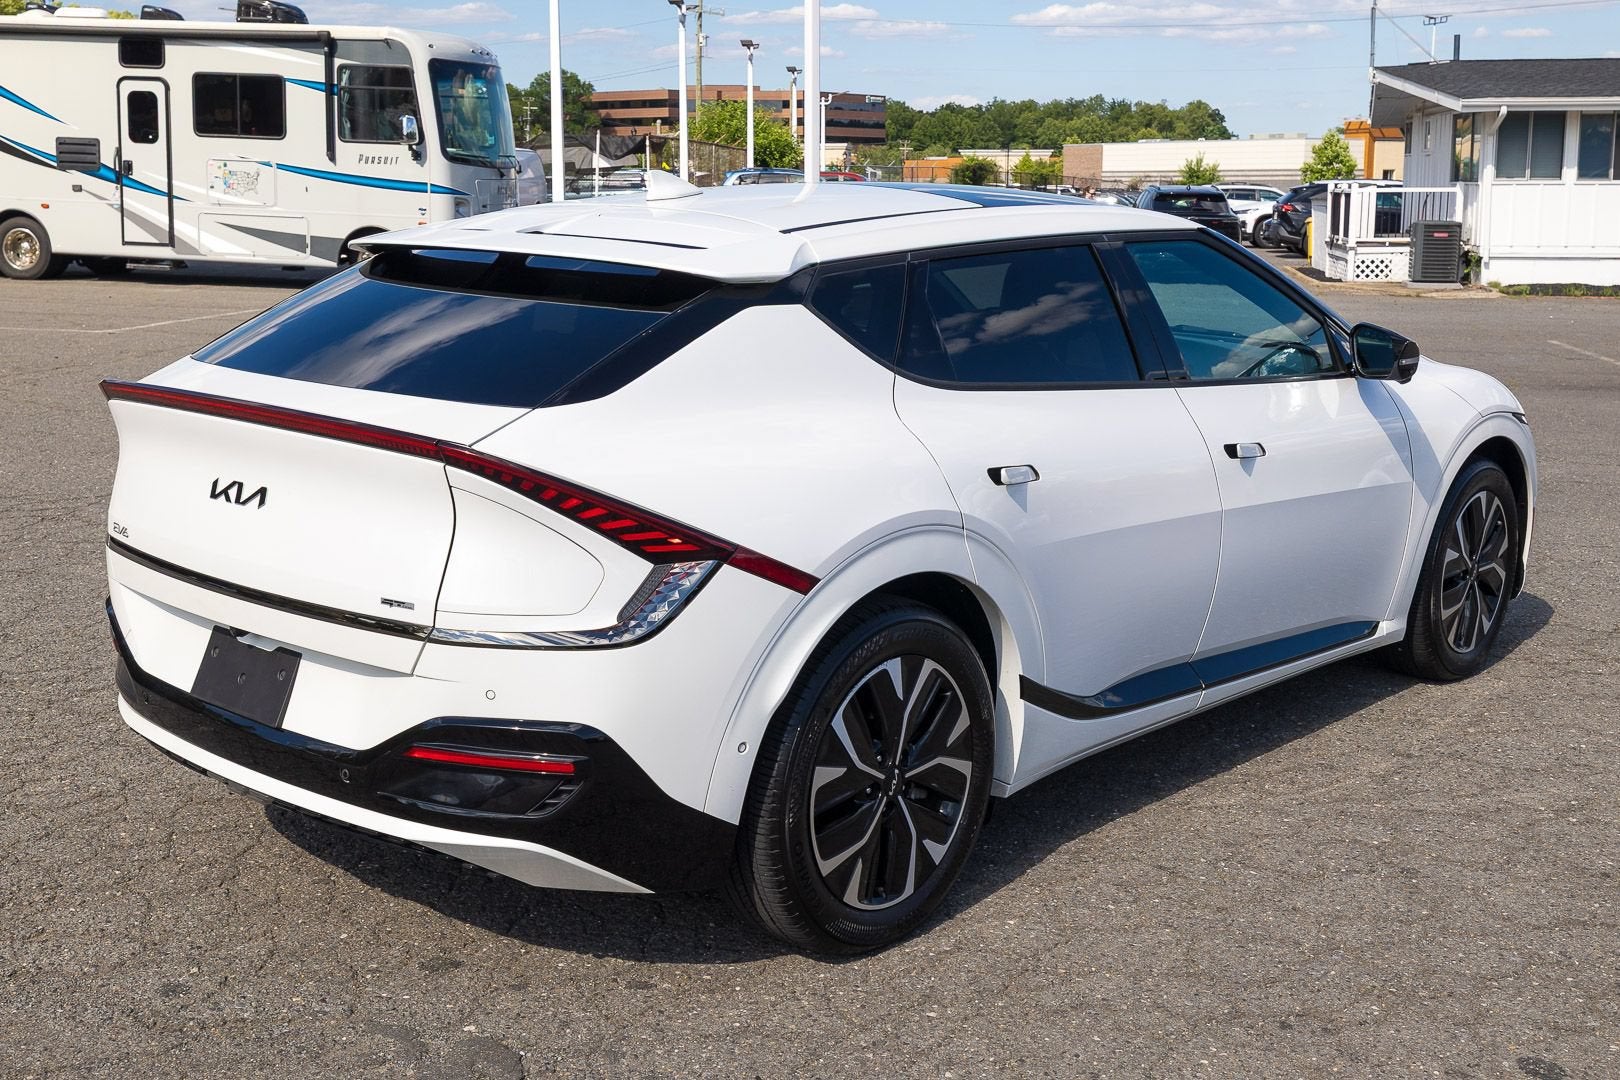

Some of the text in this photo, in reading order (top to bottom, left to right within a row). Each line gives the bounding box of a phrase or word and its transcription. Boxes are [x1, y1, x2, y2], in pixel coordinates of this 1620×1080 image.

[358, 153, 400, 166] PURSUIT
[209, 477, 267, 509] KIA
[112, 521, 129, 539] EV6
